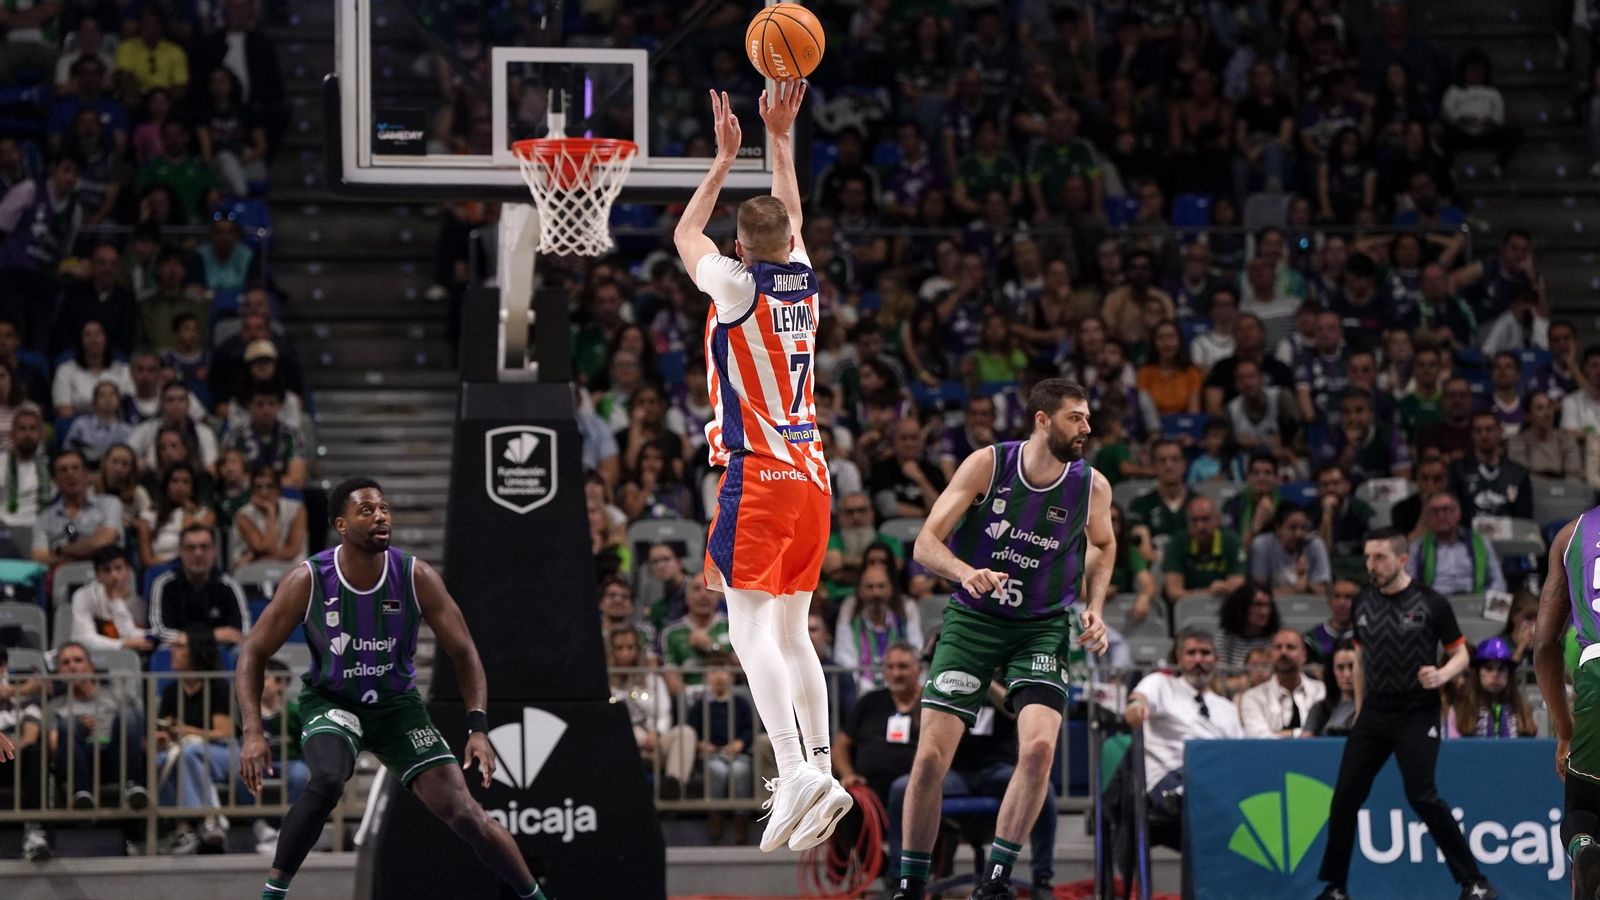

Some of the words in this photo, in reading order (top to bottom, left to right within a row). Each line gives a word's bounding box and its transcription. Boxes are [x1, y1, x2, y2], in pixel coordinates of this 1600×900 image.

[772, 272, 809, 292] JAKOVICS
[772, 305, 815, 333] LEYMA
[790, 353, 811, 414] 7
[1009, 527, 1060, 551] Unicaja
[990, 578, 1024, 608] 45
[485, 798, 598, 843] nicaja
